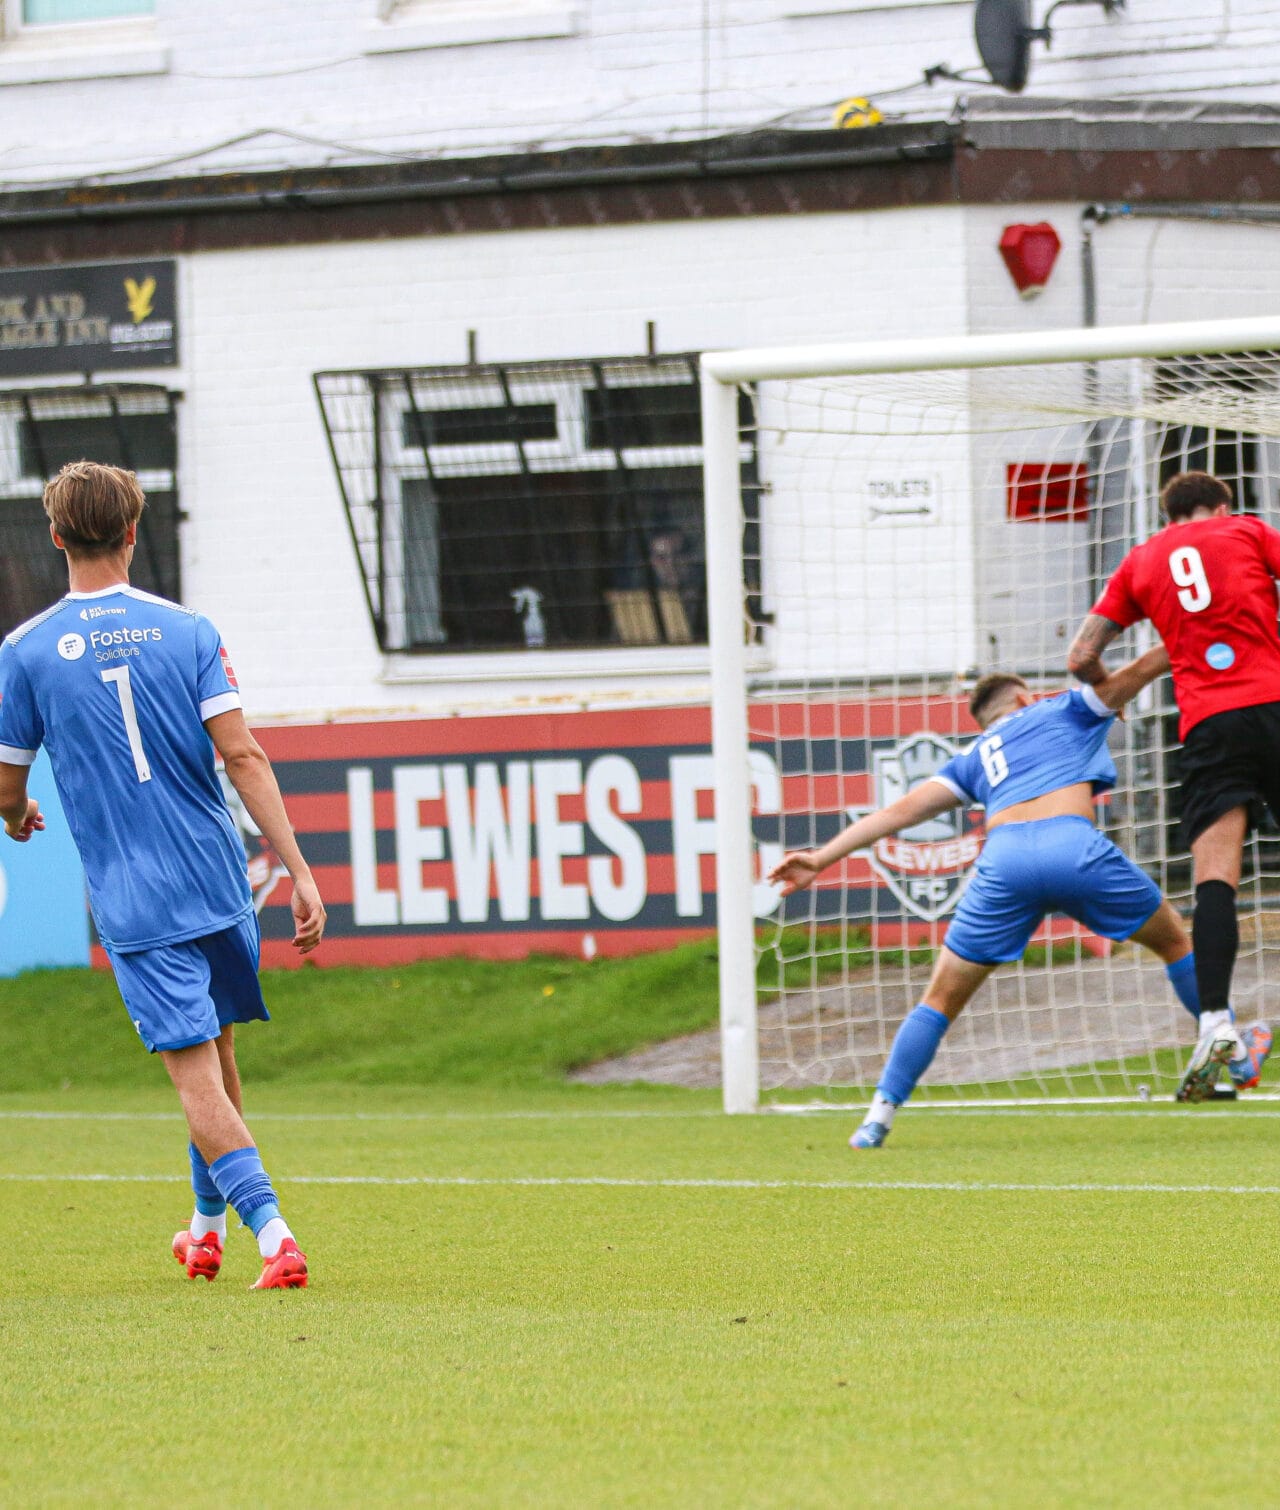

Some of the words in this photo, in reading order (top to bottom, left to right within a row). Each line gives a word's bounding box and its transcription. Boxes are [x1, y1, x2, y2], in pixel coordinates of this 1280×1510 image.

[868, 480, 931, 499] TOILETS
[1168, 545, 1212, 613] 9
[90, 627, 162, 649] Fosters
[95, 647, 140, 663] Solicitors
[100, 664, 152, 783] 7
[979, 735, 1010, 788] 6
[347, 754, 648, 927] LEWES
[669, 749, 783, 919] FC
[877, 834, 979, 871] LEWES
[910, 879, 949, 900] FC
